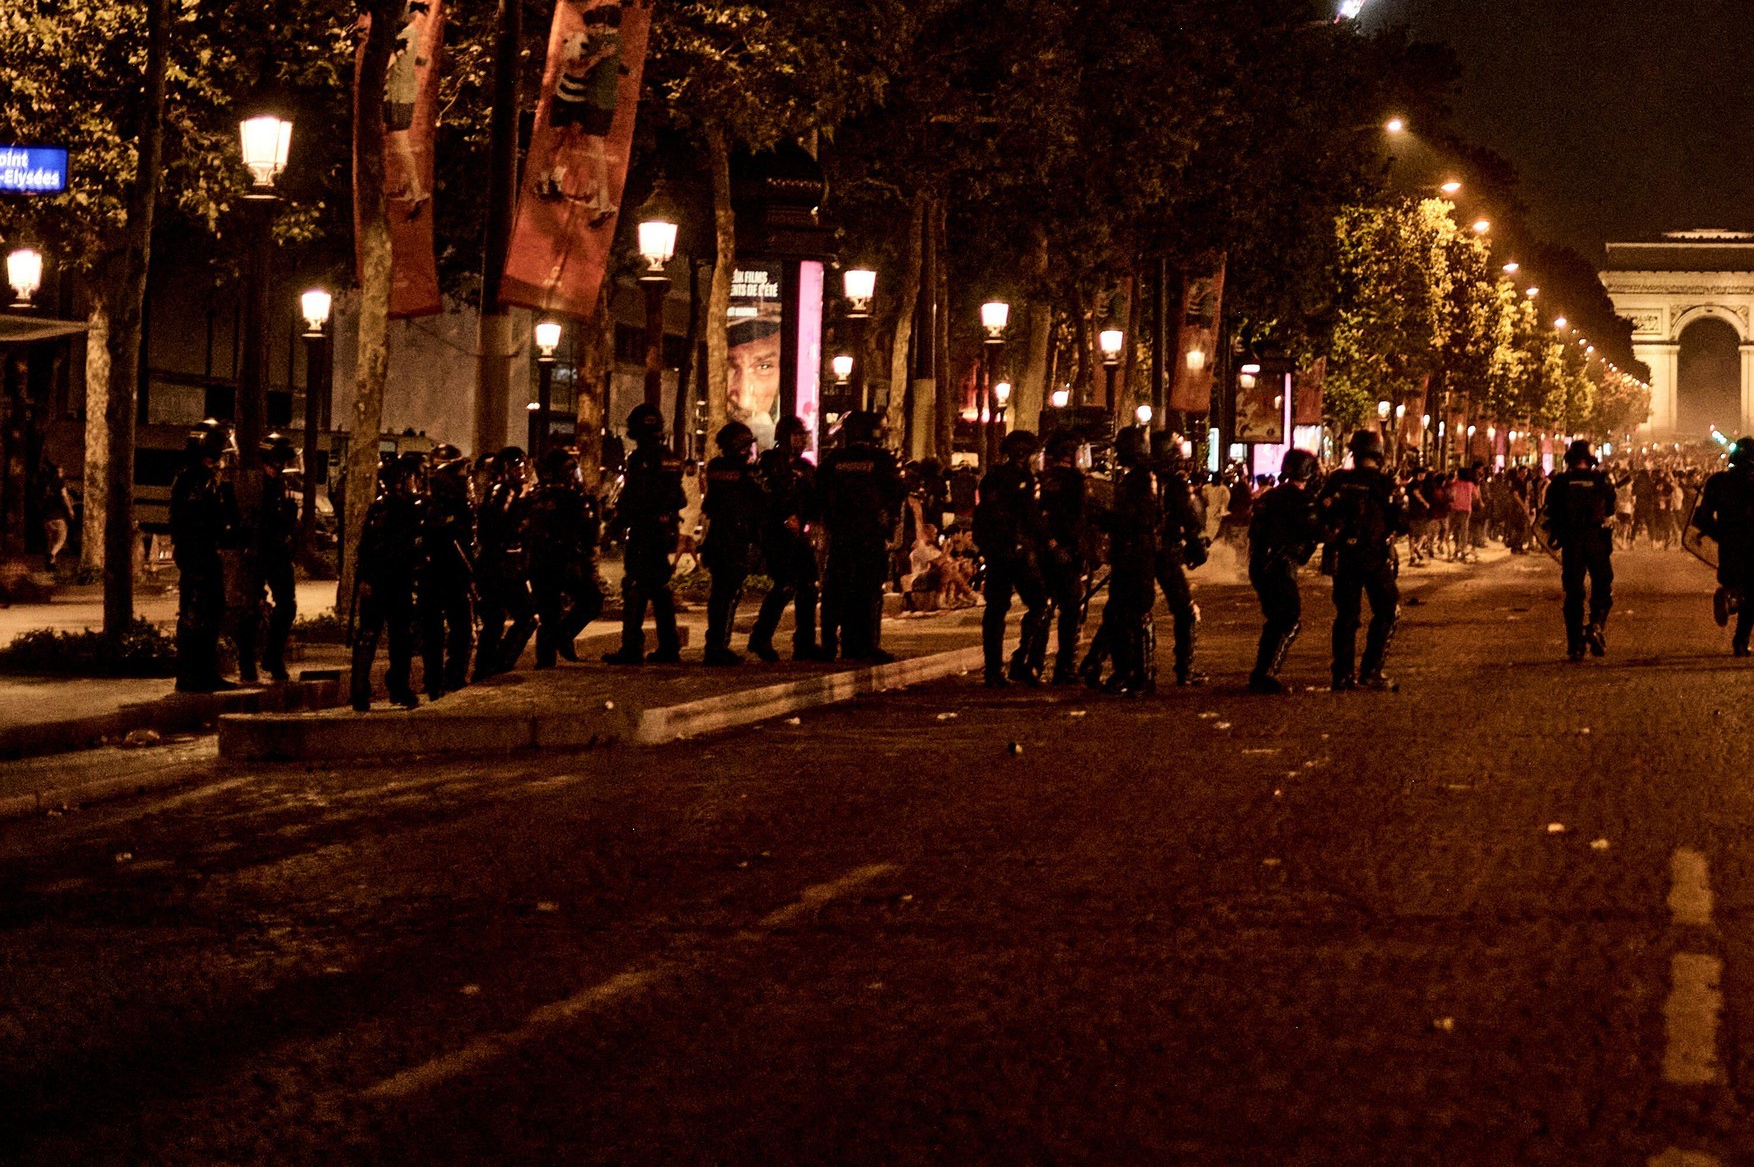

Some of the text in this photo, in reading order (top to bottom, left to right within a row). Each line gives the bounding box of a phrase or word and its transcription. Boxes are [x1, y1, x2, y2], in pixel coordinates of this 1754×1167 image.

[0, 148, 29, 167] oint
[0, 167, 60, 188] -Elysées
[745, 270, 768, 283] FILMS
[746, 283, 758, 297] DE
